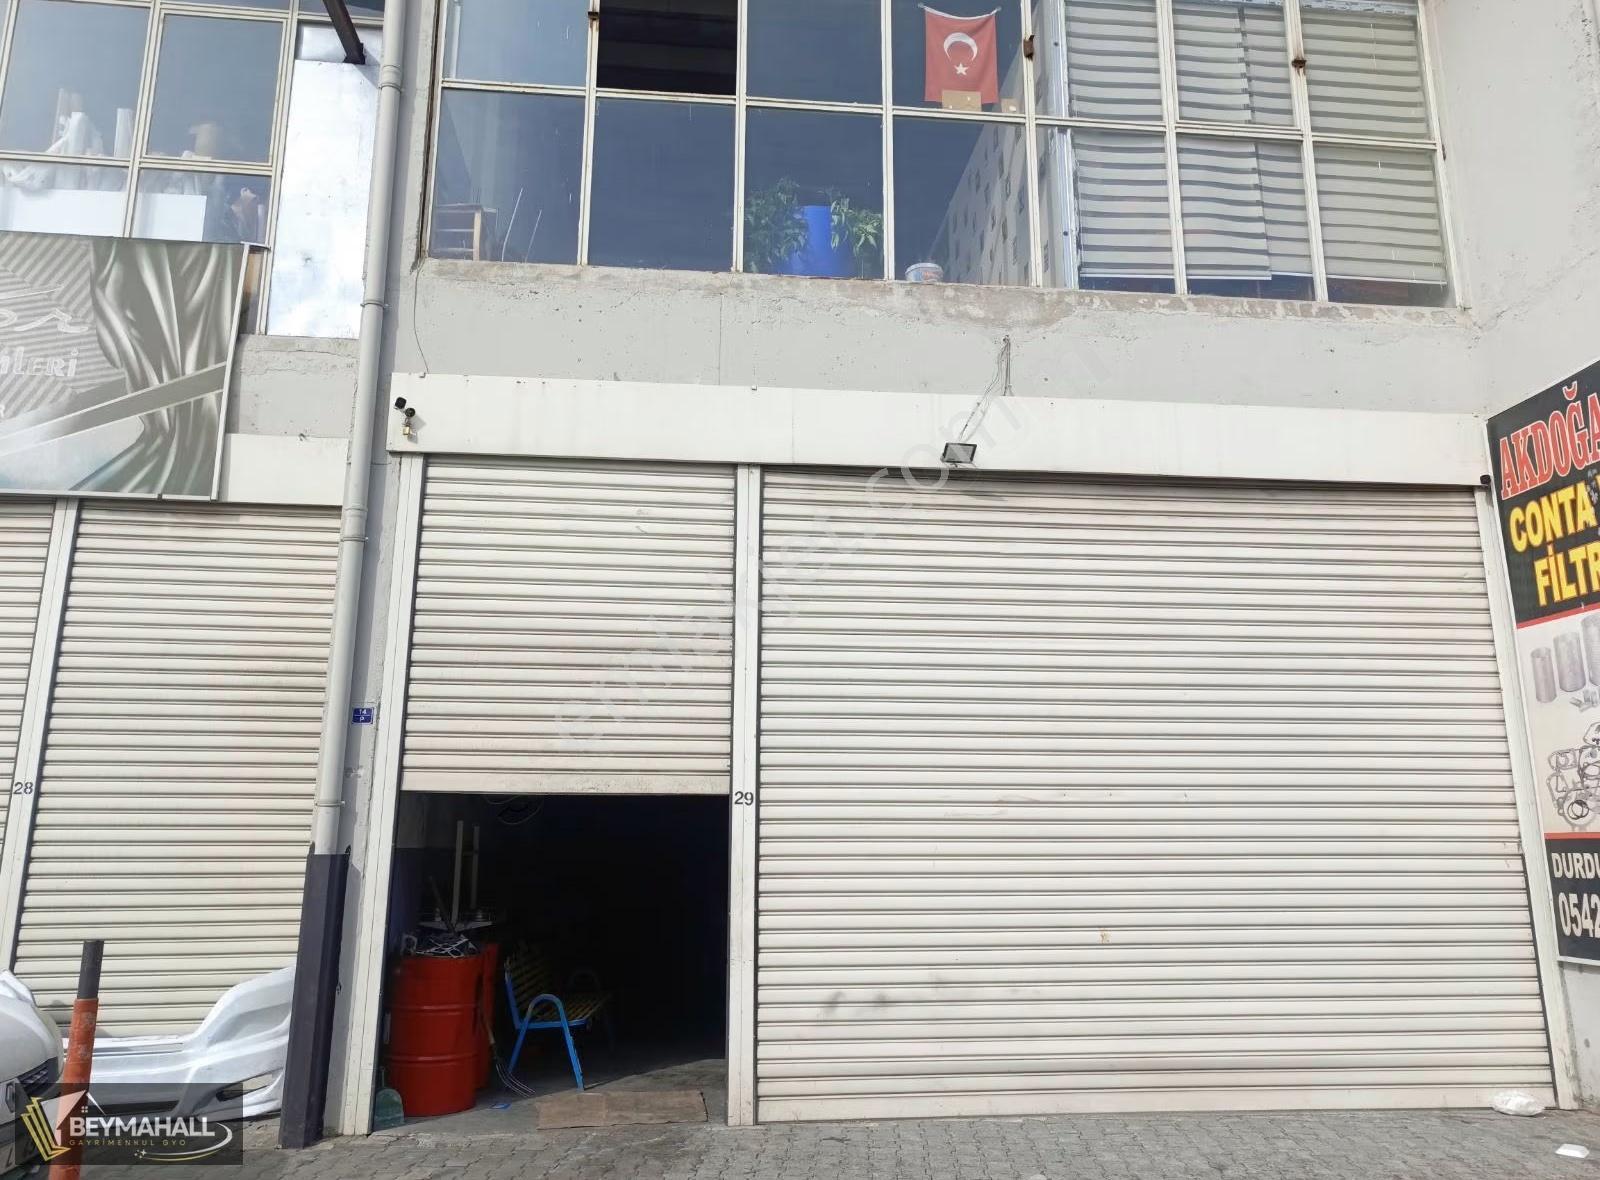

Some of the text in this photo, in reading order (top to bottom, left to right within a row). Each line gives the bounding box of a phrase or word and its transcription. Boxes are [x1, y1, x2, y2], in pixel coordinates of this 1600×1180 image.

[1510, 480, 1597, 552] CONTA
[13, 781, 33, 795] 28
[734, 791, 754, 806] 29
[1558, 892, 1600, 938] 0542
